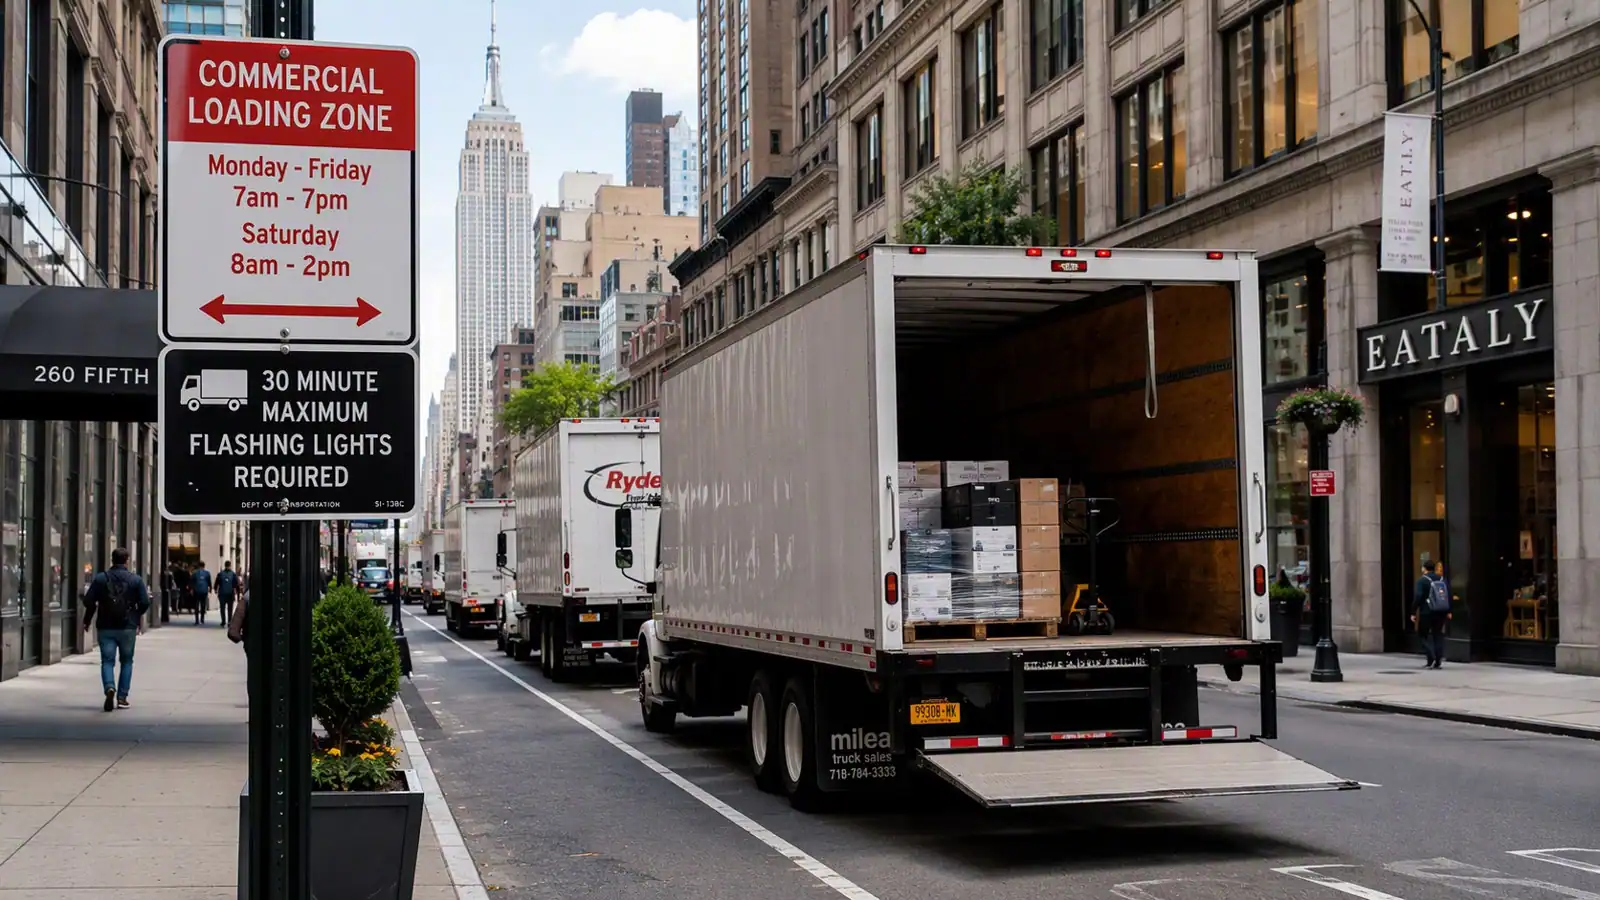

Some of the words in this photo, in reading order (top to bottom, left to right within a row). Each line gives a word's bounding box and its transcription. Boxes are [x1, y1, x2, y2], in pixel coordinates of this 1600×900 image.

[199, 59, 384, 94] COMMERCIAL
[188, 97, 311, 128] LOADING
[320, 103, 393, 132] ZONE
[208, 154, 288, 182] Monday
[308, 158, 372, 185] Friday
[234, 186, 279, 208] 7am
[303, 188, 348, 214] 7pm
[242, 222, 339, 251] Saturday
[231, 253, 278, 274] 8am
[303, 255, 350, 281] 2pm
[1366, 299, 1543, 371] EATALY
[34, 365, 75, 383] 260
[84, 366, 149, 384] FIFTH
[261, 370, 290, 392] 30
[297, 370, 379, 392] MINUTE
[262, 401, 368, 422] MAXIMUM
[189, 434, 304, 455] FLASHING
[313, 434, 393, 456] LIGHTS
[234, 466, 349, 489] REQUIRED
[241, 501, 260, 509] DEPT
[263, 501, 274, 509] OF
[831, 728, 891, 750] milea
[832, 753, 861, 764] truck
[864, 752, 892, 763] sales
[829, 766, 896, 780] 718-784-3333
